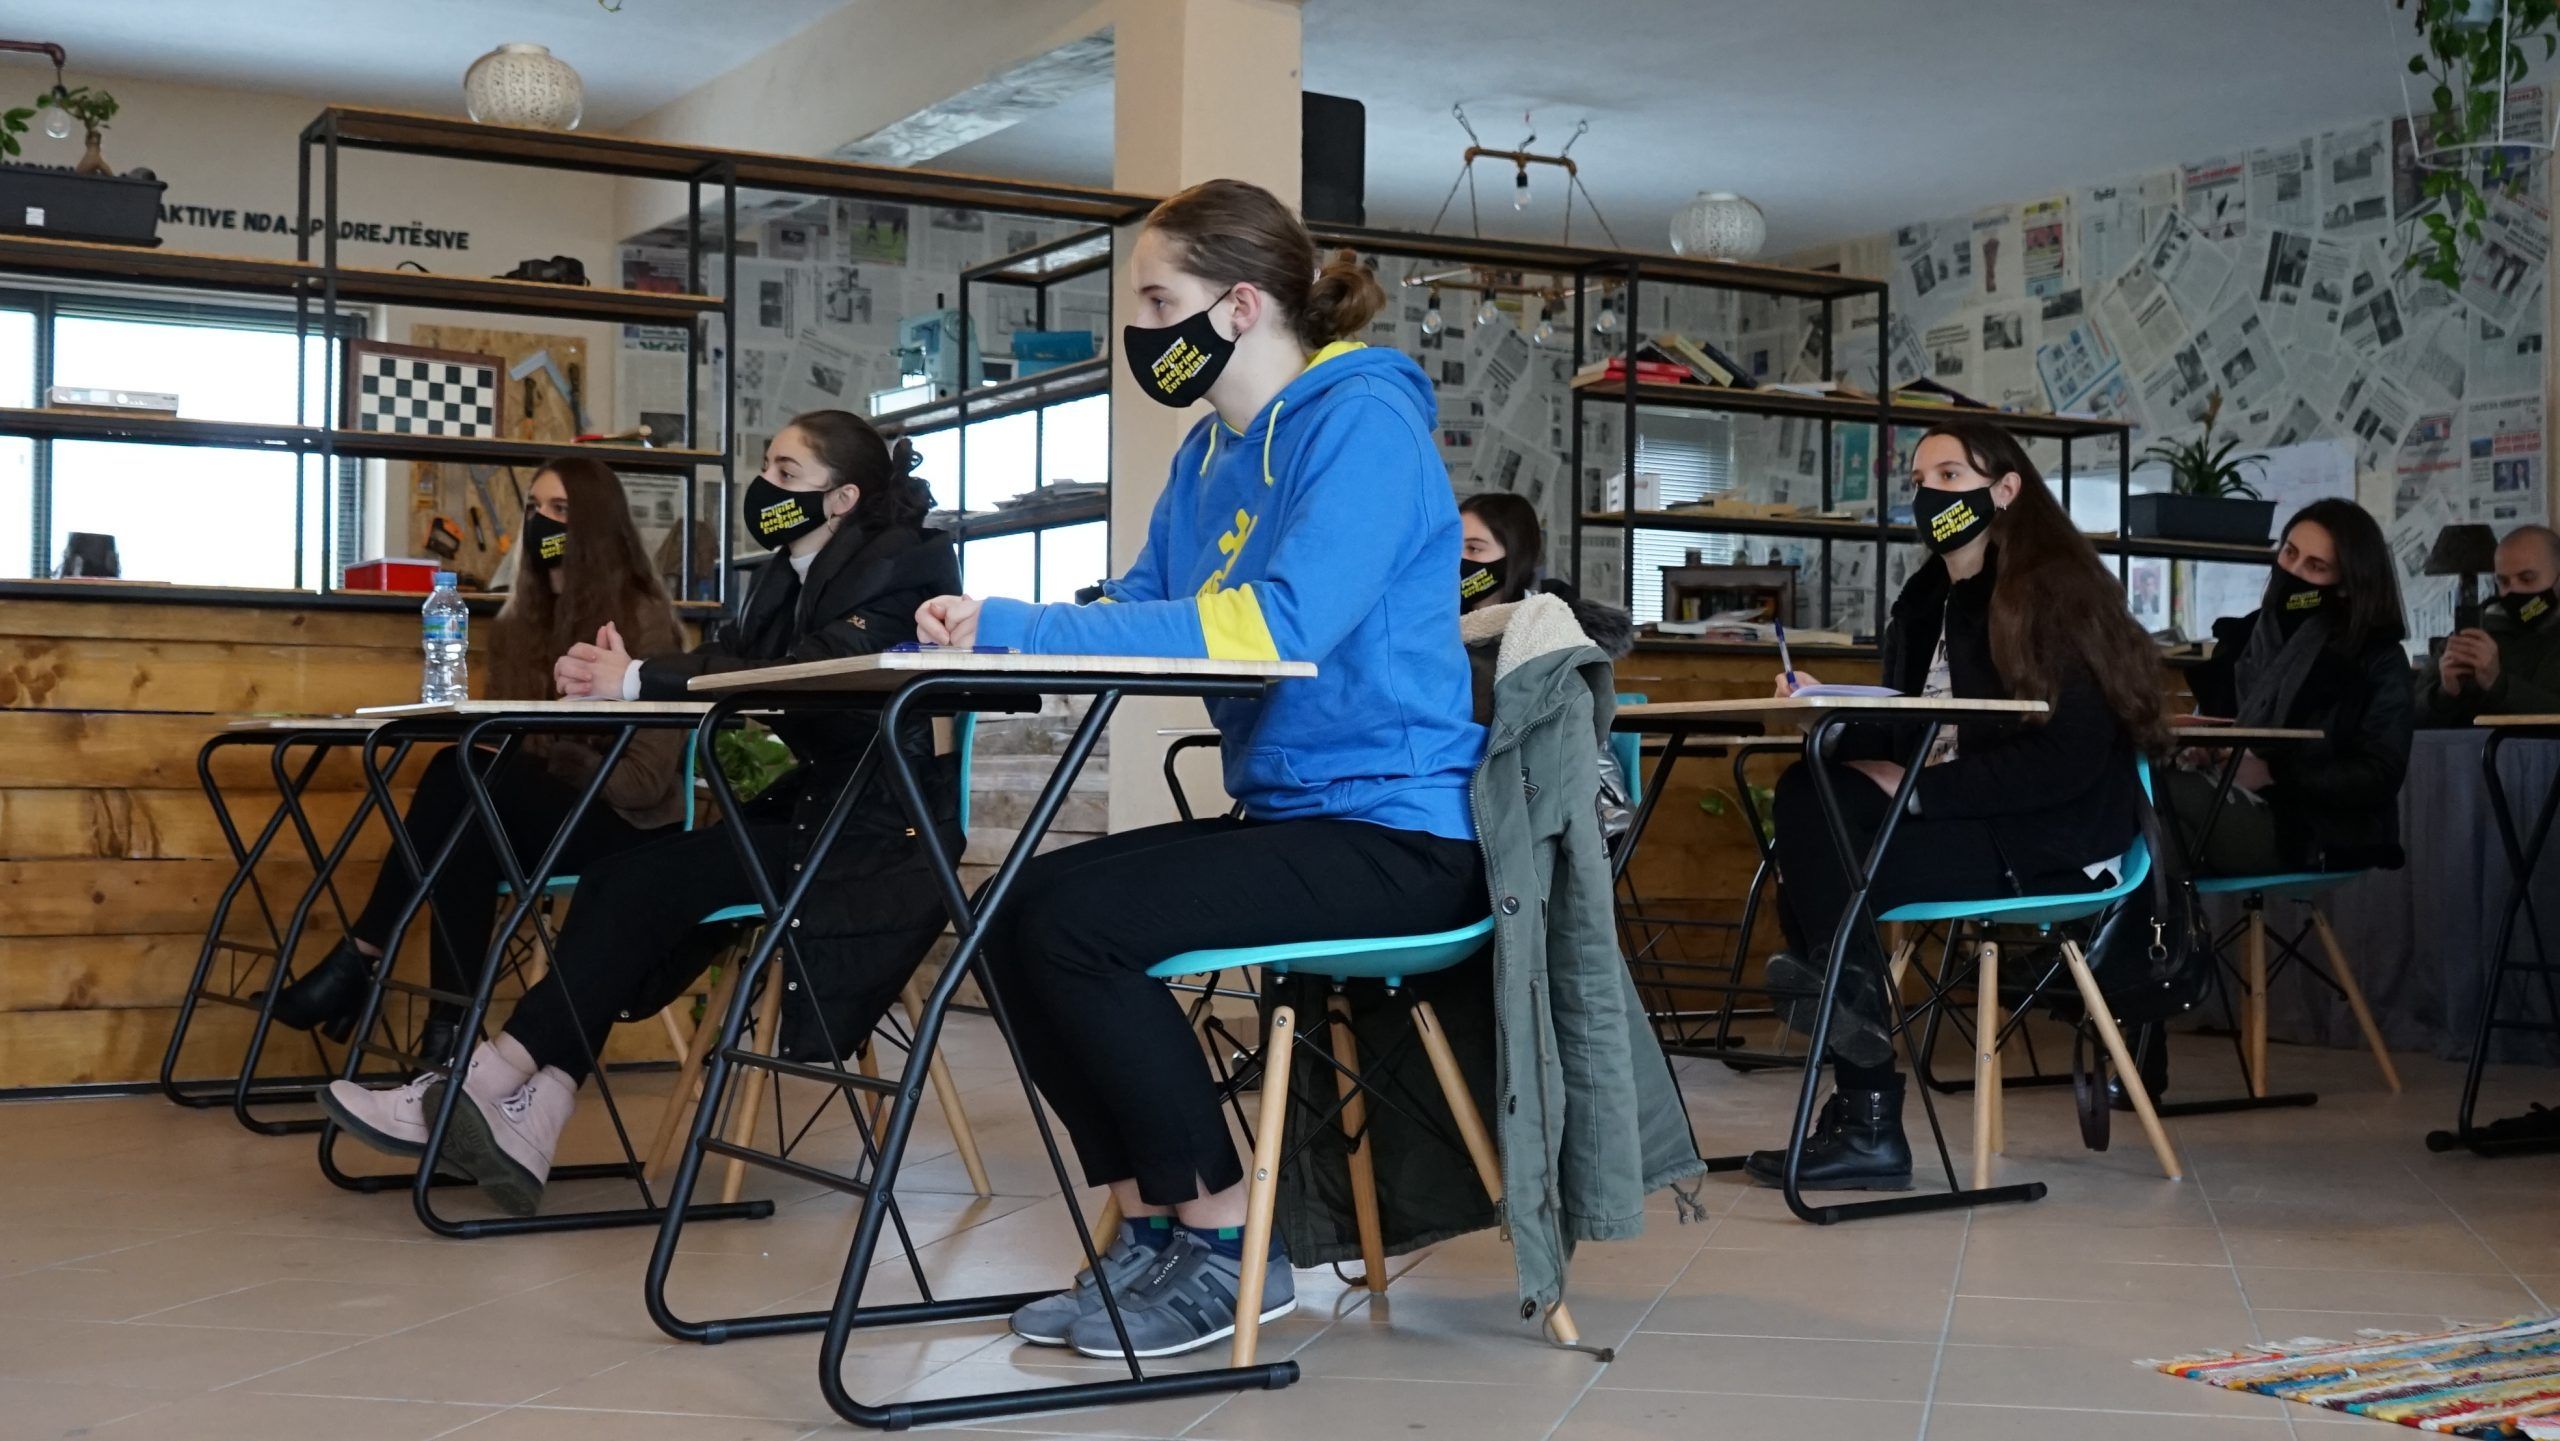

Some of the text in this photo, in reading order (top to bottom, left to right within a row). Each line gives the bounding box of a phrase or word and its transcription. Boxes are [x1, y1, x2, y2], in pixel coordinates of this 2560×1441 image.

[156, 204, 237, 229] AKTIVE
[310, 218, 469, 250] PDREJTËSIVE
[1157, 345, 1199, 389] Integrimi
